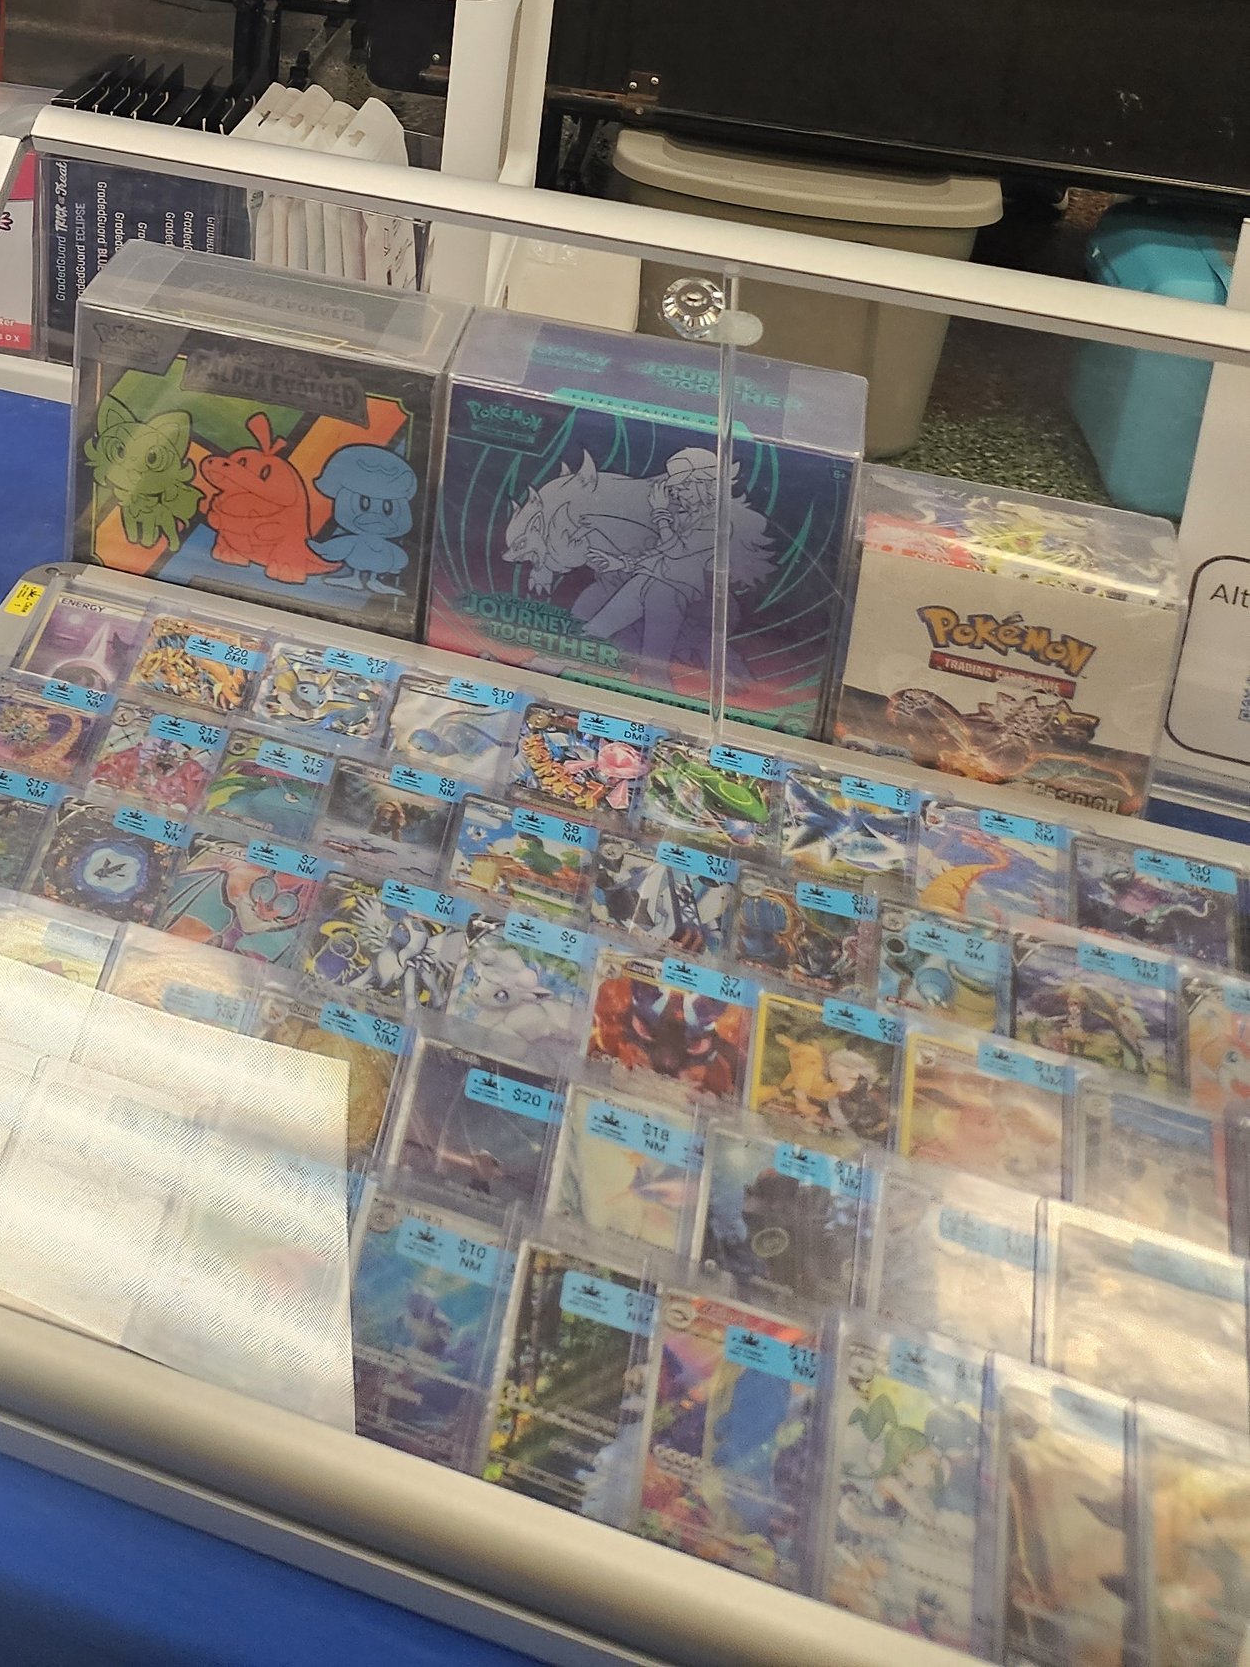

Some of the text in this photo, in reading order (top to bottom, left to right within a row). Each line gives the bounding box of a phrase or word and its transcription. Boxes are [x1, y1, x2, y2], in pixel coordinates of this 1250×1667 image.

[55, 161, 68, 196] Treat
[97, 182, 108, 247] GradedGuard
[75, 203, 86, 242] ECLIPSE
[56, 235, 66, 301] GradedGuard
[61, 597, 106, 614] ENERGY
[462, 592, 572, 633] JOURNEY
[489, 621, 619, 669] TOGETHER
[367, 656, 388, 669] $12
[369, 665, 385, 675] LP
[491, 687, 515, 702] $10
[494, 696, 510, 706] LP
[198, 726, 221, 739] $15
[630, 722, 646, 734] $8
[197, 733, 219, 746] NM
[302, 754, 325, 767] $15
[25, 776, 48, 790] $15
[27, 787, 46, 799] NM
[563, 822, 581, 835] $8
[562, 832, 583, 845] NM
[300, 854, 318, 867] $7
[722, 974, 741, 987] $7
[719, 986, 742, 1000] NM
[372, 1019, 401, 1035] $22
[374, 1033, 397, 1048] NM
[512, 1090, 541, 1108] $20
[644, 1139, 666, 1154] NM
[457, 1239, 487, 1259] $10
